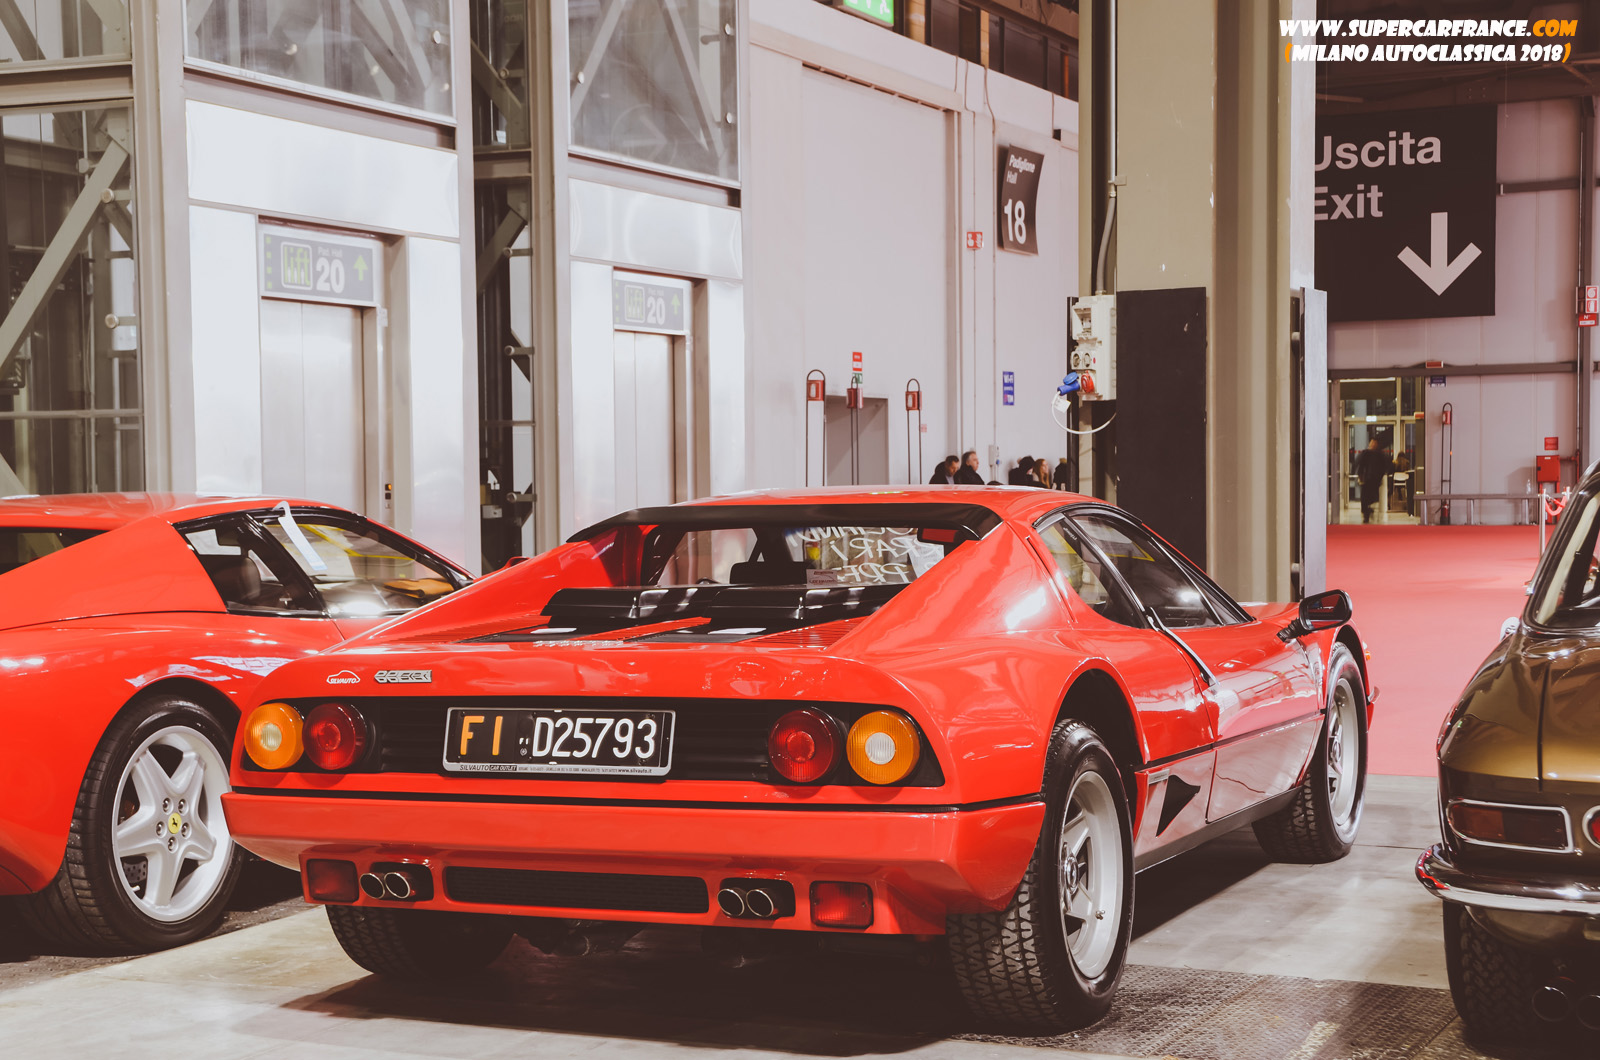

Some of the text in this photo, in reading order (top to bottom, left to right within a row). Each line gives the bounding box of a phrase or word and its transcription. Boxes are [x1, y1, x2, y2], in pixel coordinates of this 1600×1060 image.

[1007, 170, 1018, 184] Hall
[1004, 198, 1027, 245] 18
[316, 257, 345, 293] 20
[646, 296, 665, 325] 20
[532, 717, 657, 758] D25793
